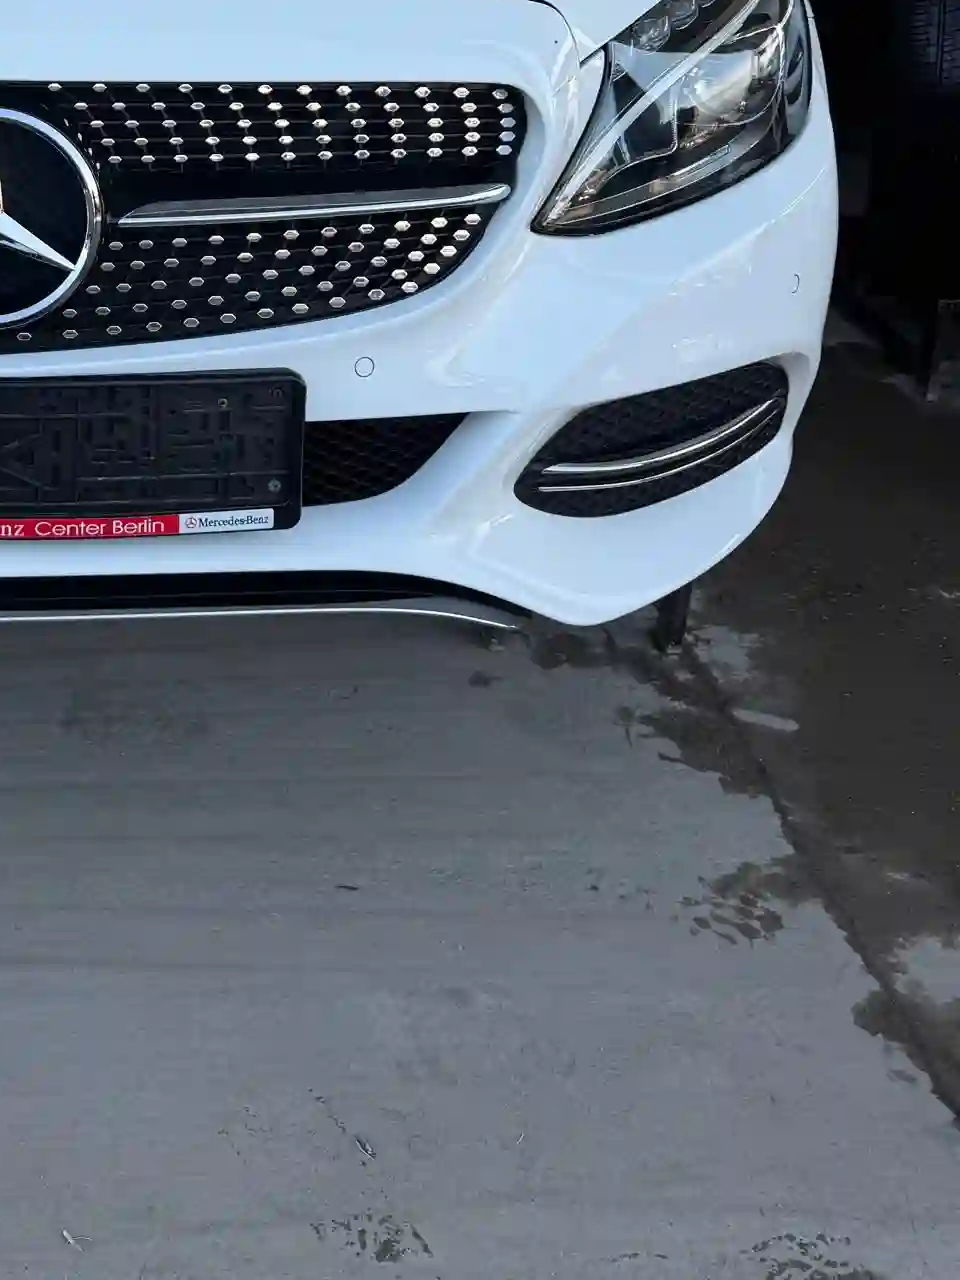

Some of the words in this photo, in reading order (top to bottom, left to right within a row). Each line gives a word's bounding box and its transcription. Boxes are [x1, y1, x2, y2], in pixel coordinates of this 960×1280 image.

[34, 519, 107, 536] Center
[112, 516, 165, 535] Berlin
[198, 515, 269, 528] Mercedes-Benz
